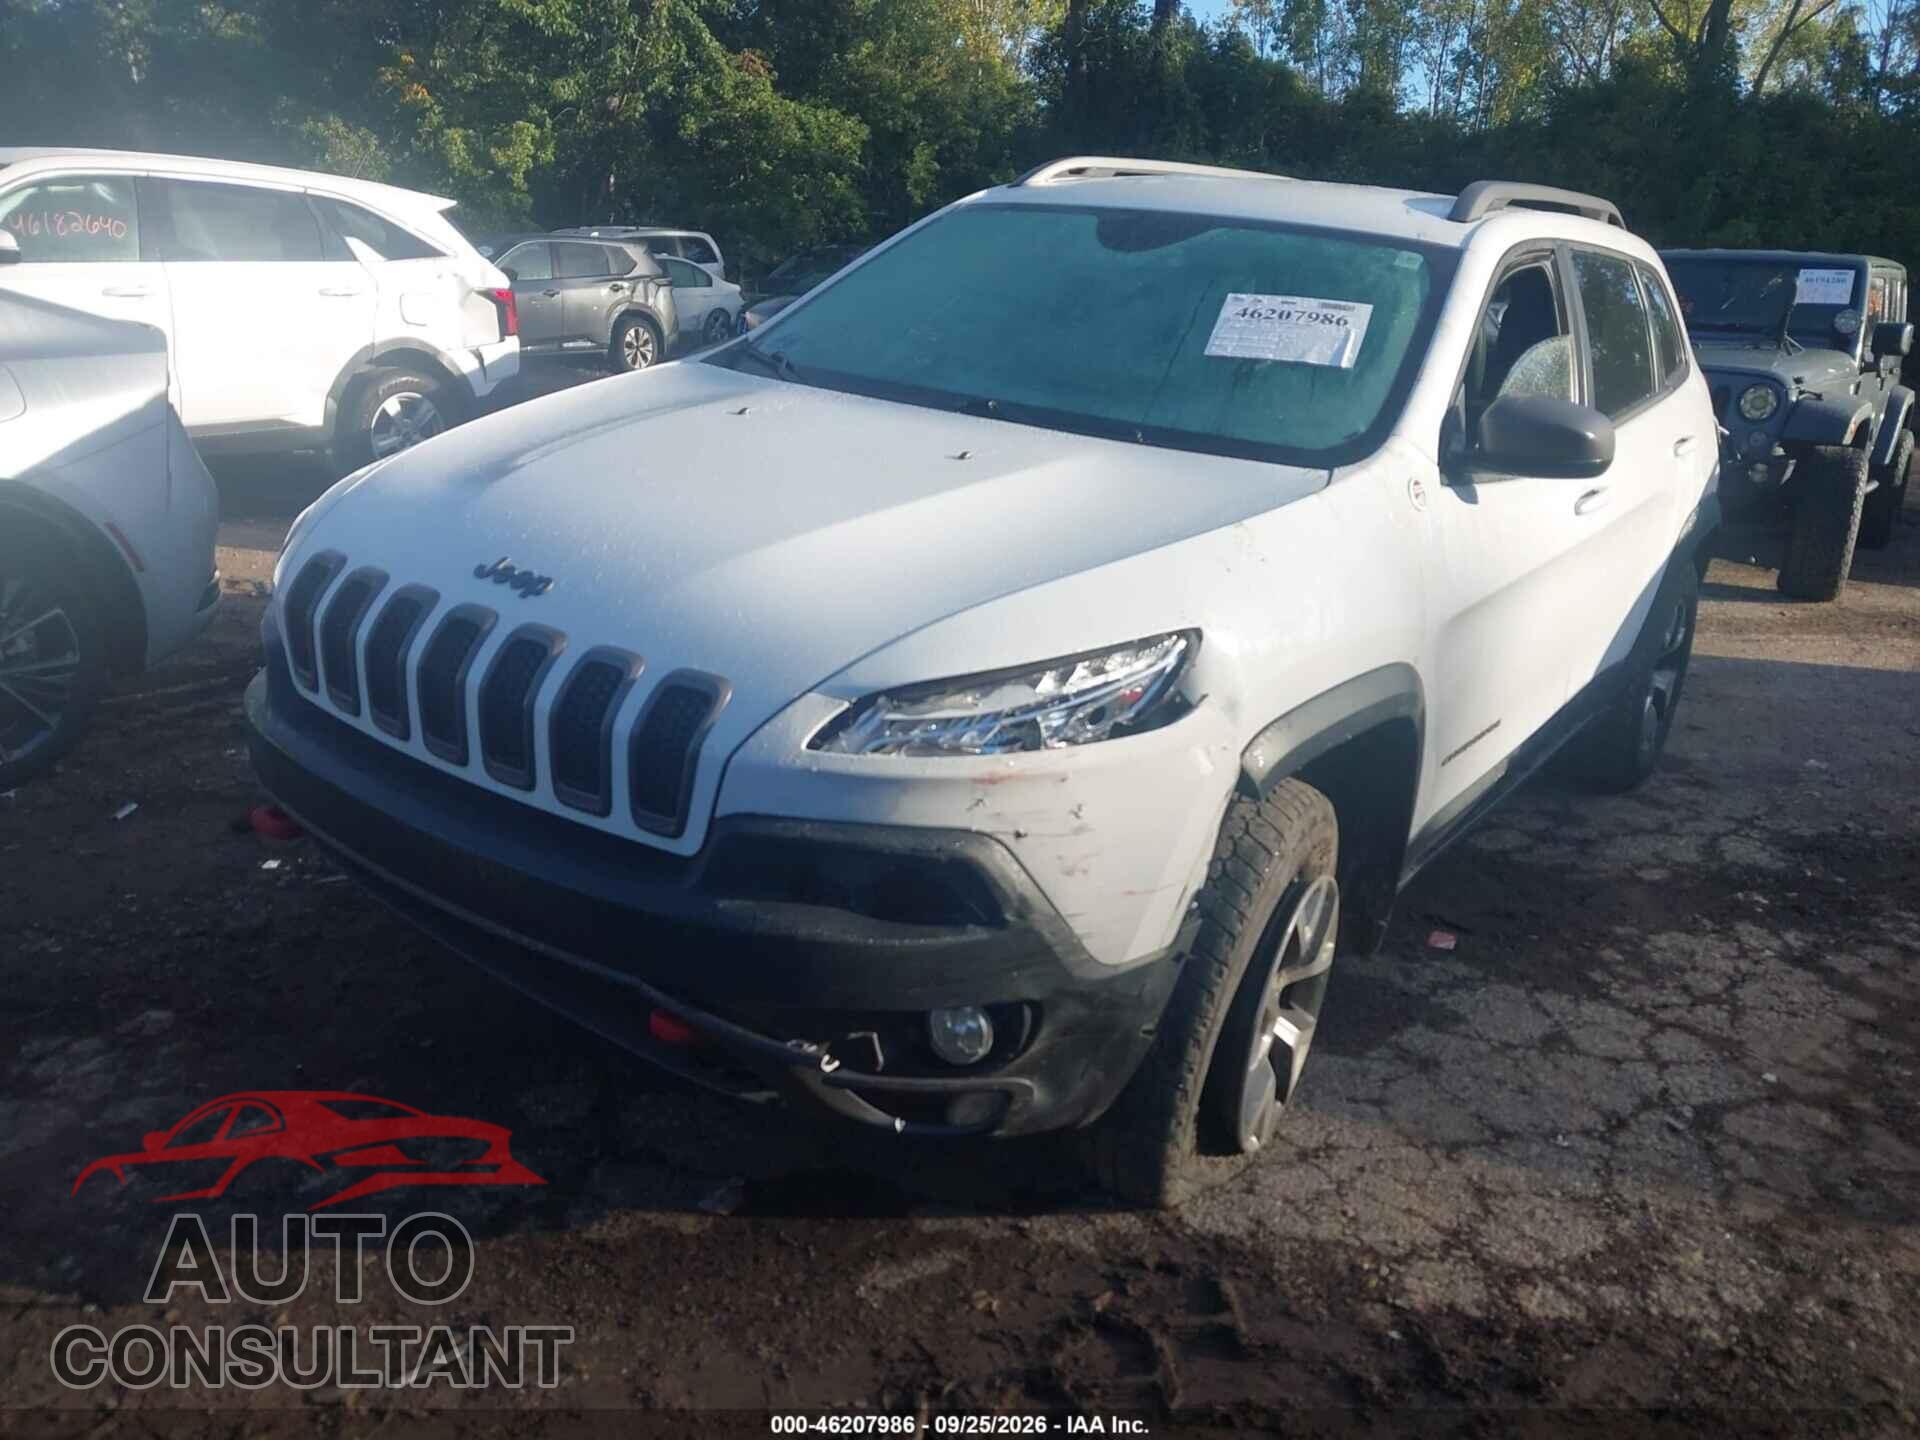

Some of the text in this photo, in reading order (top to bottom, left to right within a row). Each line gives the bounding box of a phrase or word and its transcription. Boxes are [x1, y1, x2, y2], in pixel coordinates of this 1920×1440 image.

[9, 211, 128, 238] 46182640
[1234, 306, 1350, 327] 46207986
[473, 556, 555, 599] Jeep
